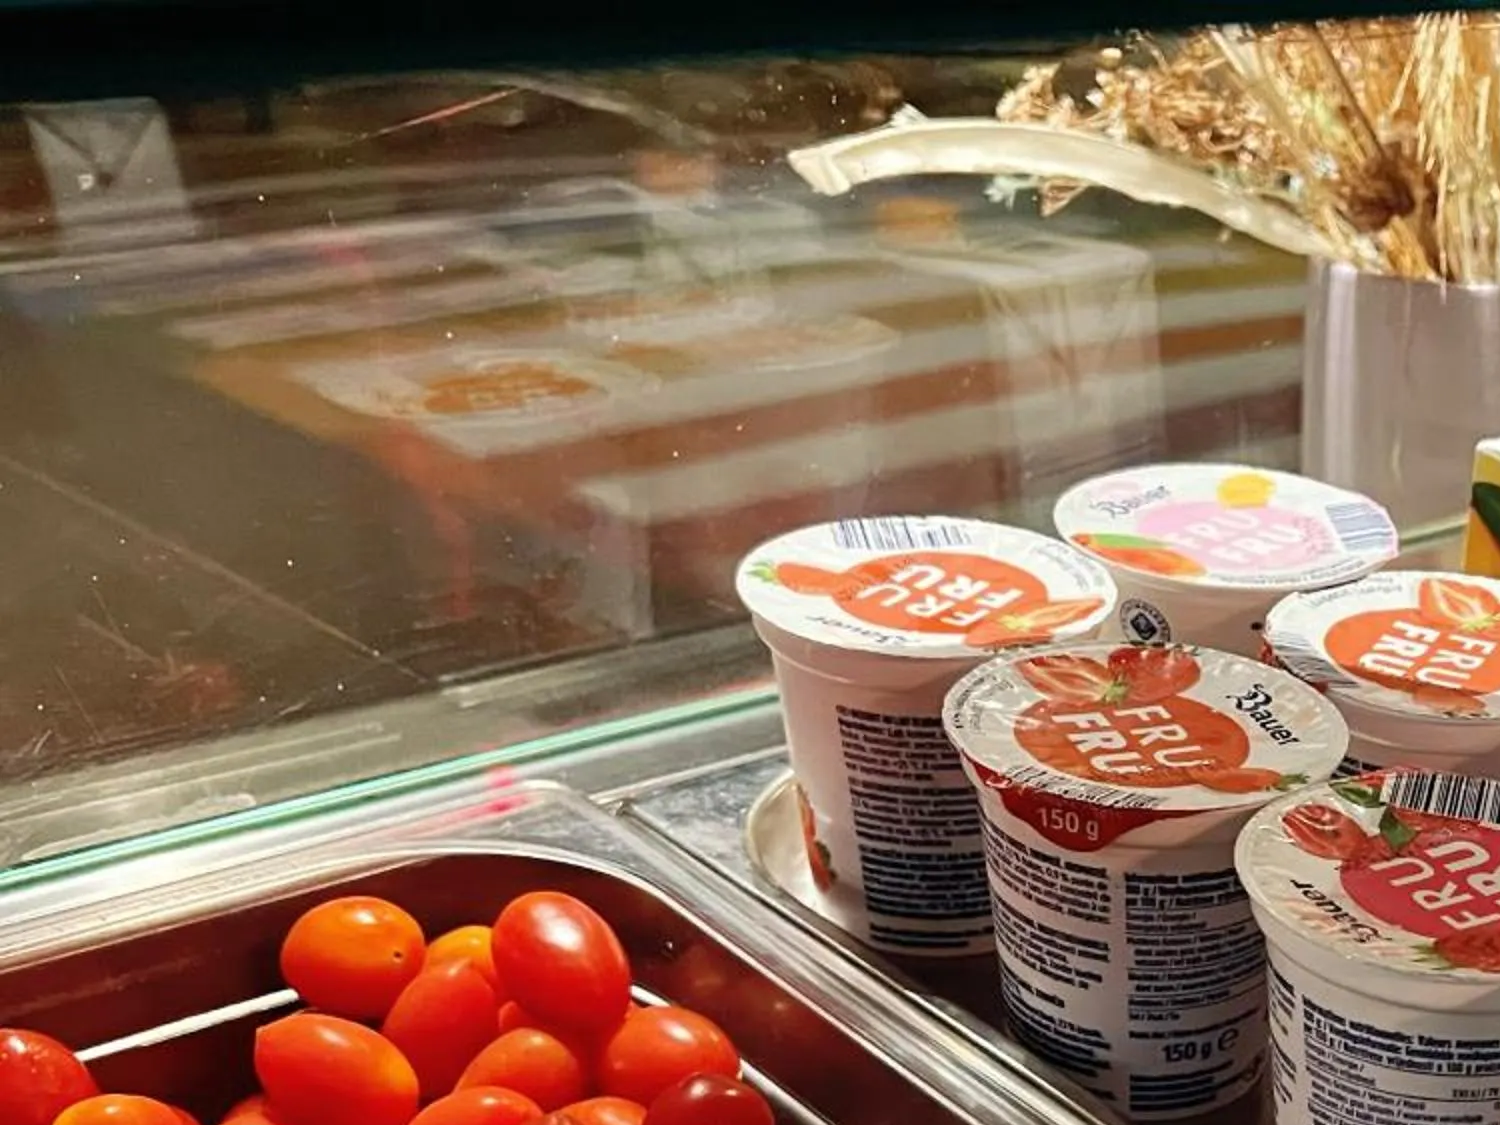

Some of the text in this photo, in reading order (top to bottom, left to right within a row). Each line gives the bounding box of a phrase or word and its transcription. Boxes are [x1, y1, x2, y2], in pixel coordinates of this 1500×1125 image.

[1089, 484, 1171, 519] Bauer
[1164, 512, 1261, 548] FRU
[1210, 523, 1302, 563] FRU
[856, 583, 991, 626] FRU
[889, 564, 1024, 611] FRU
[1360, 621, 1440, 678] FRU
[1415, 633, 1496, 690] FRU
[1113, 704, 1206, 768] FRU
[1226, 683, 1301, 747] Bauer
[1052, 711, 1143, 774] FRU
[1036, 806, 1099, 841] 150 g
[1290, 878, 1392, 945] Bauer
[1162, 1041, 1196, 1063] 150
[1201, 1041, 1212, 1060] g
